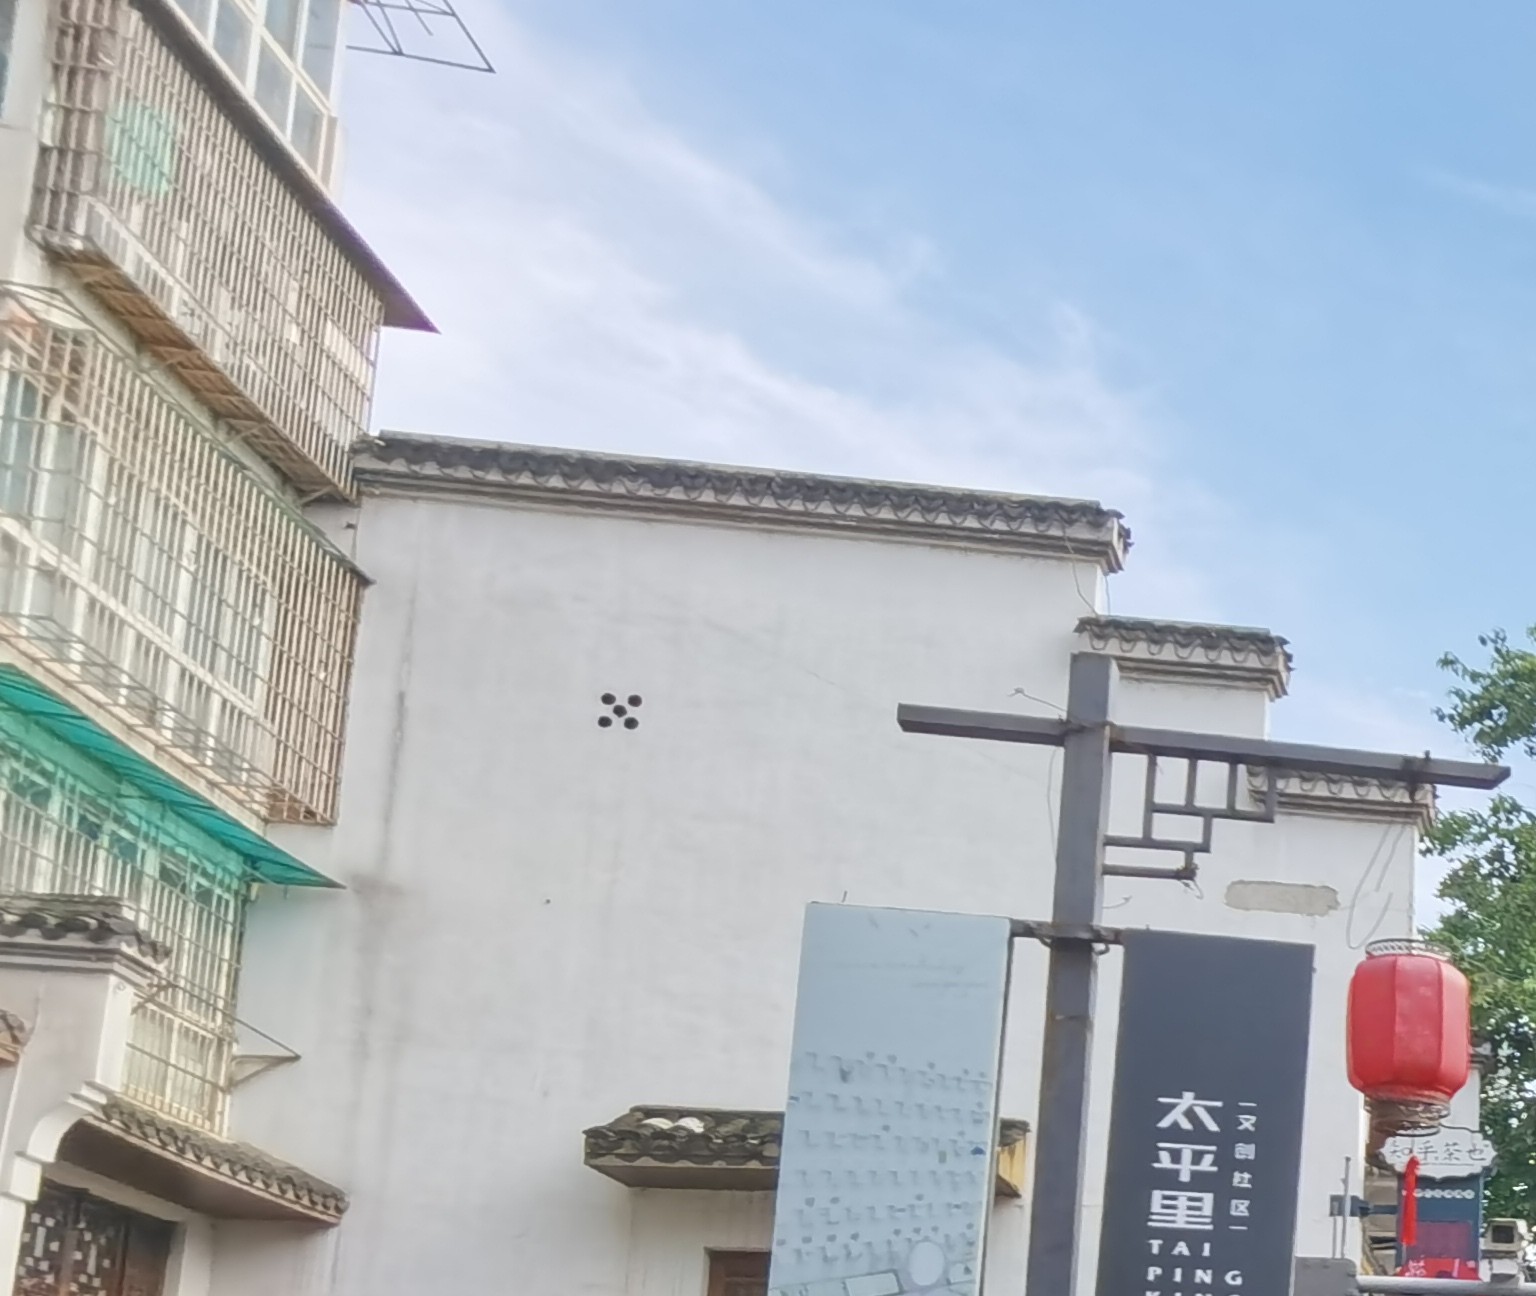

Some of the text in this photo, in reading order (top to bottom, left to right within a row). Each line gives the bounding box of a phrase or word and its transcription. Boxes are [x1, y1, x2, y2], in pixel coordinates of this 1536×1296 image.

[1147, 1091, 1224, 1231] 太平里
[1147, 1238, 1212, 1257] TAI
[1146, 1266, 1244, 1286] PING
